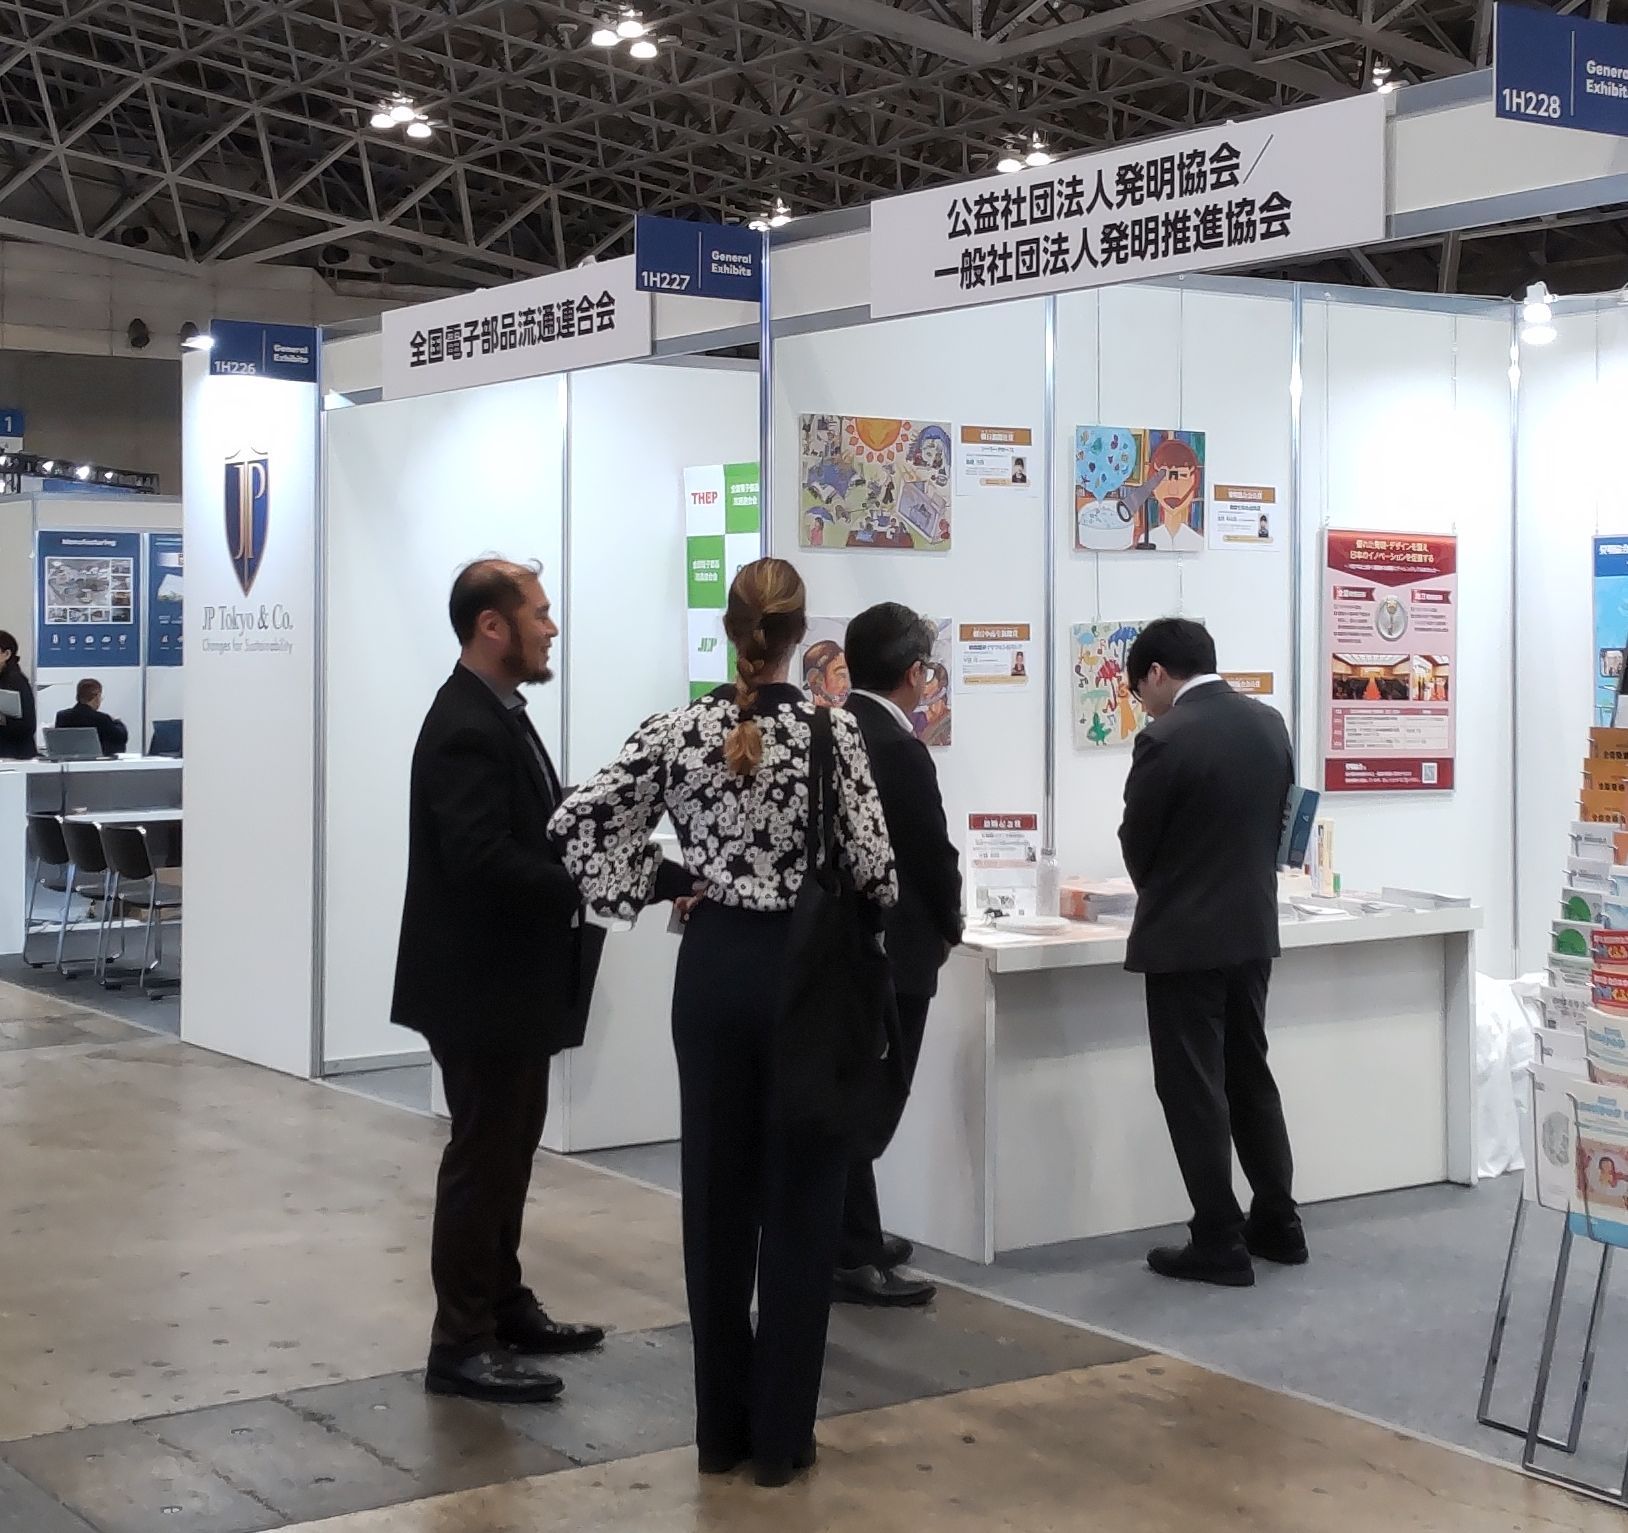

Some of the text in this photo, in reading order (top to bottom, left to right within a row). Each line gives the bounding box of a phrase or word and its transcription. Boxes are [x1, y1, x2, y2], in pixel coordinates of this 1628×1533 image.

[1503, 88, 1561, 119] 1H228
[934, 191, 1293, 290] 一般社団法人発明推進協会
[711, 250, 752, 265] General
[711, 262, 752, 277] Exhibits
[641, 271, 691, 290] 1H227
[410, 290, 616, 368] 全国電子部品流通連合会
[214, 360, 257, 375] 1H226
[690, 491, 718, 505] THEP
[202, 603, 294, 637] JP Tokyo & Co.
